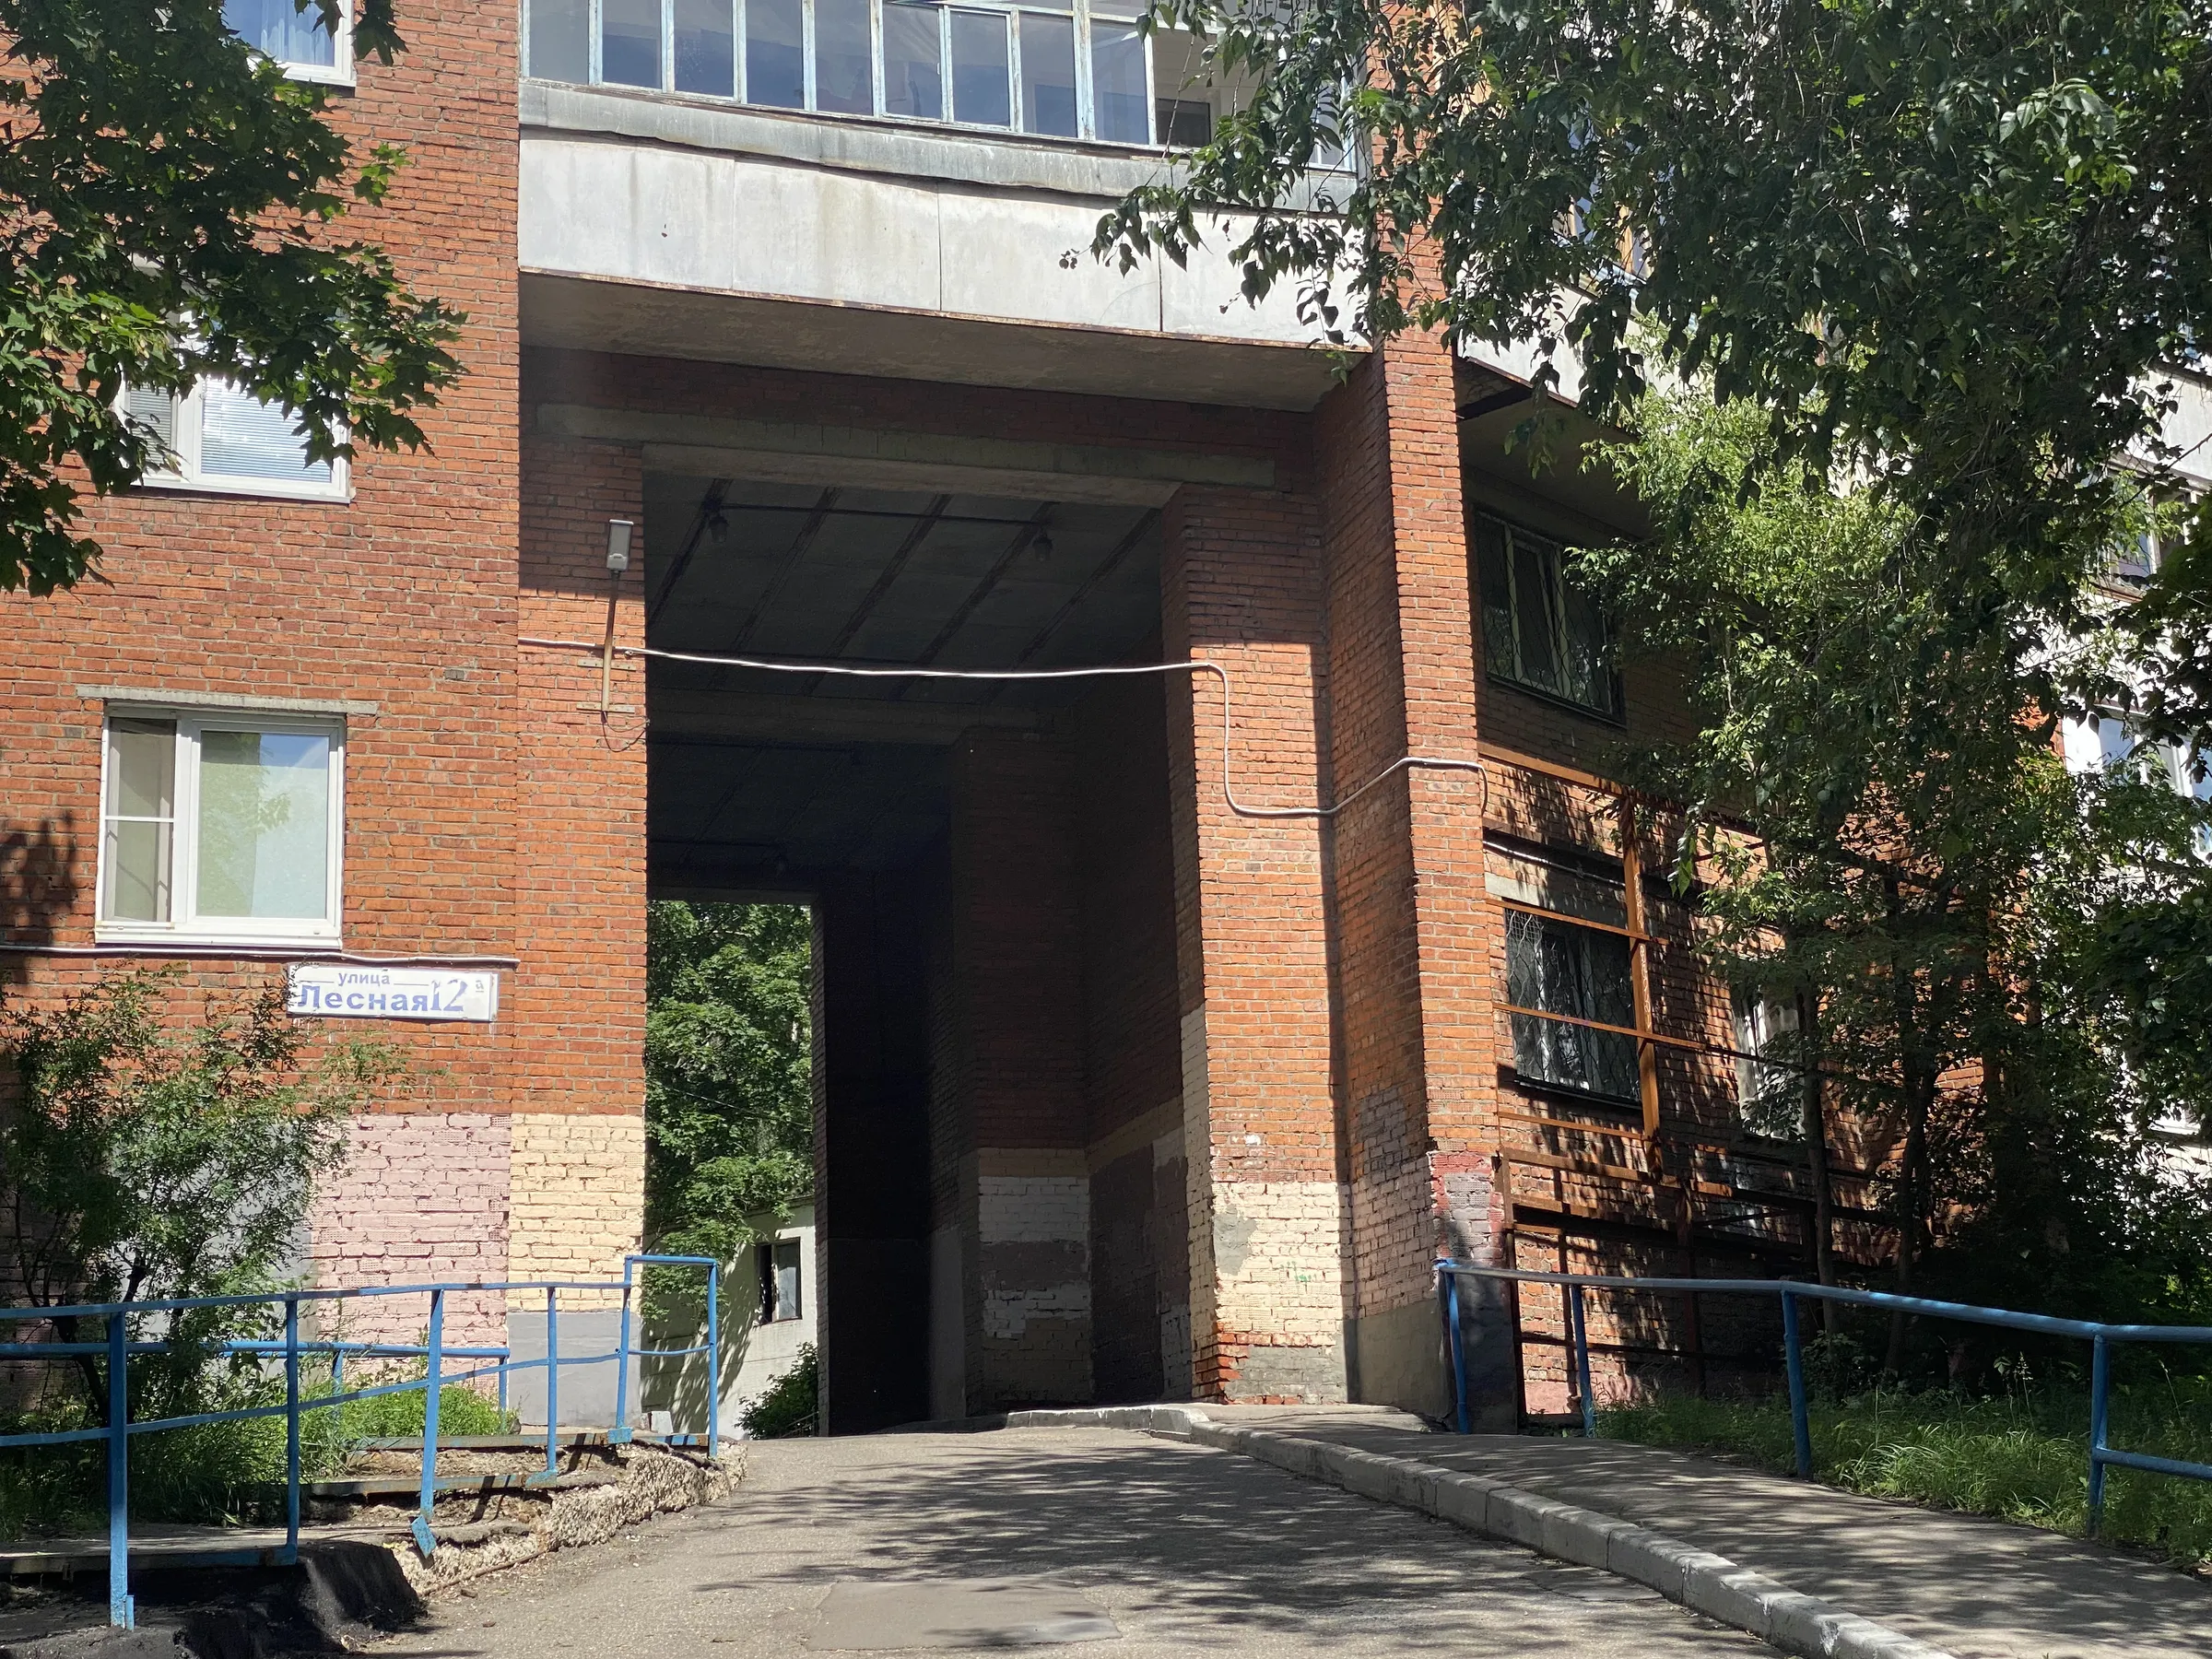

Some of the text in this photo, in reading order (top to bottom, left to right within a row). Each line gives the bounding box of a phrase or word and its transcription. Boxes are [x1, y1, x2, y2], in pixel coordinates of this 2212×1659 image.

[338, 972, 391, 986] улица
[298, 984, 429, 1011] Лесная
[430, 979, 468, 1012] 12
